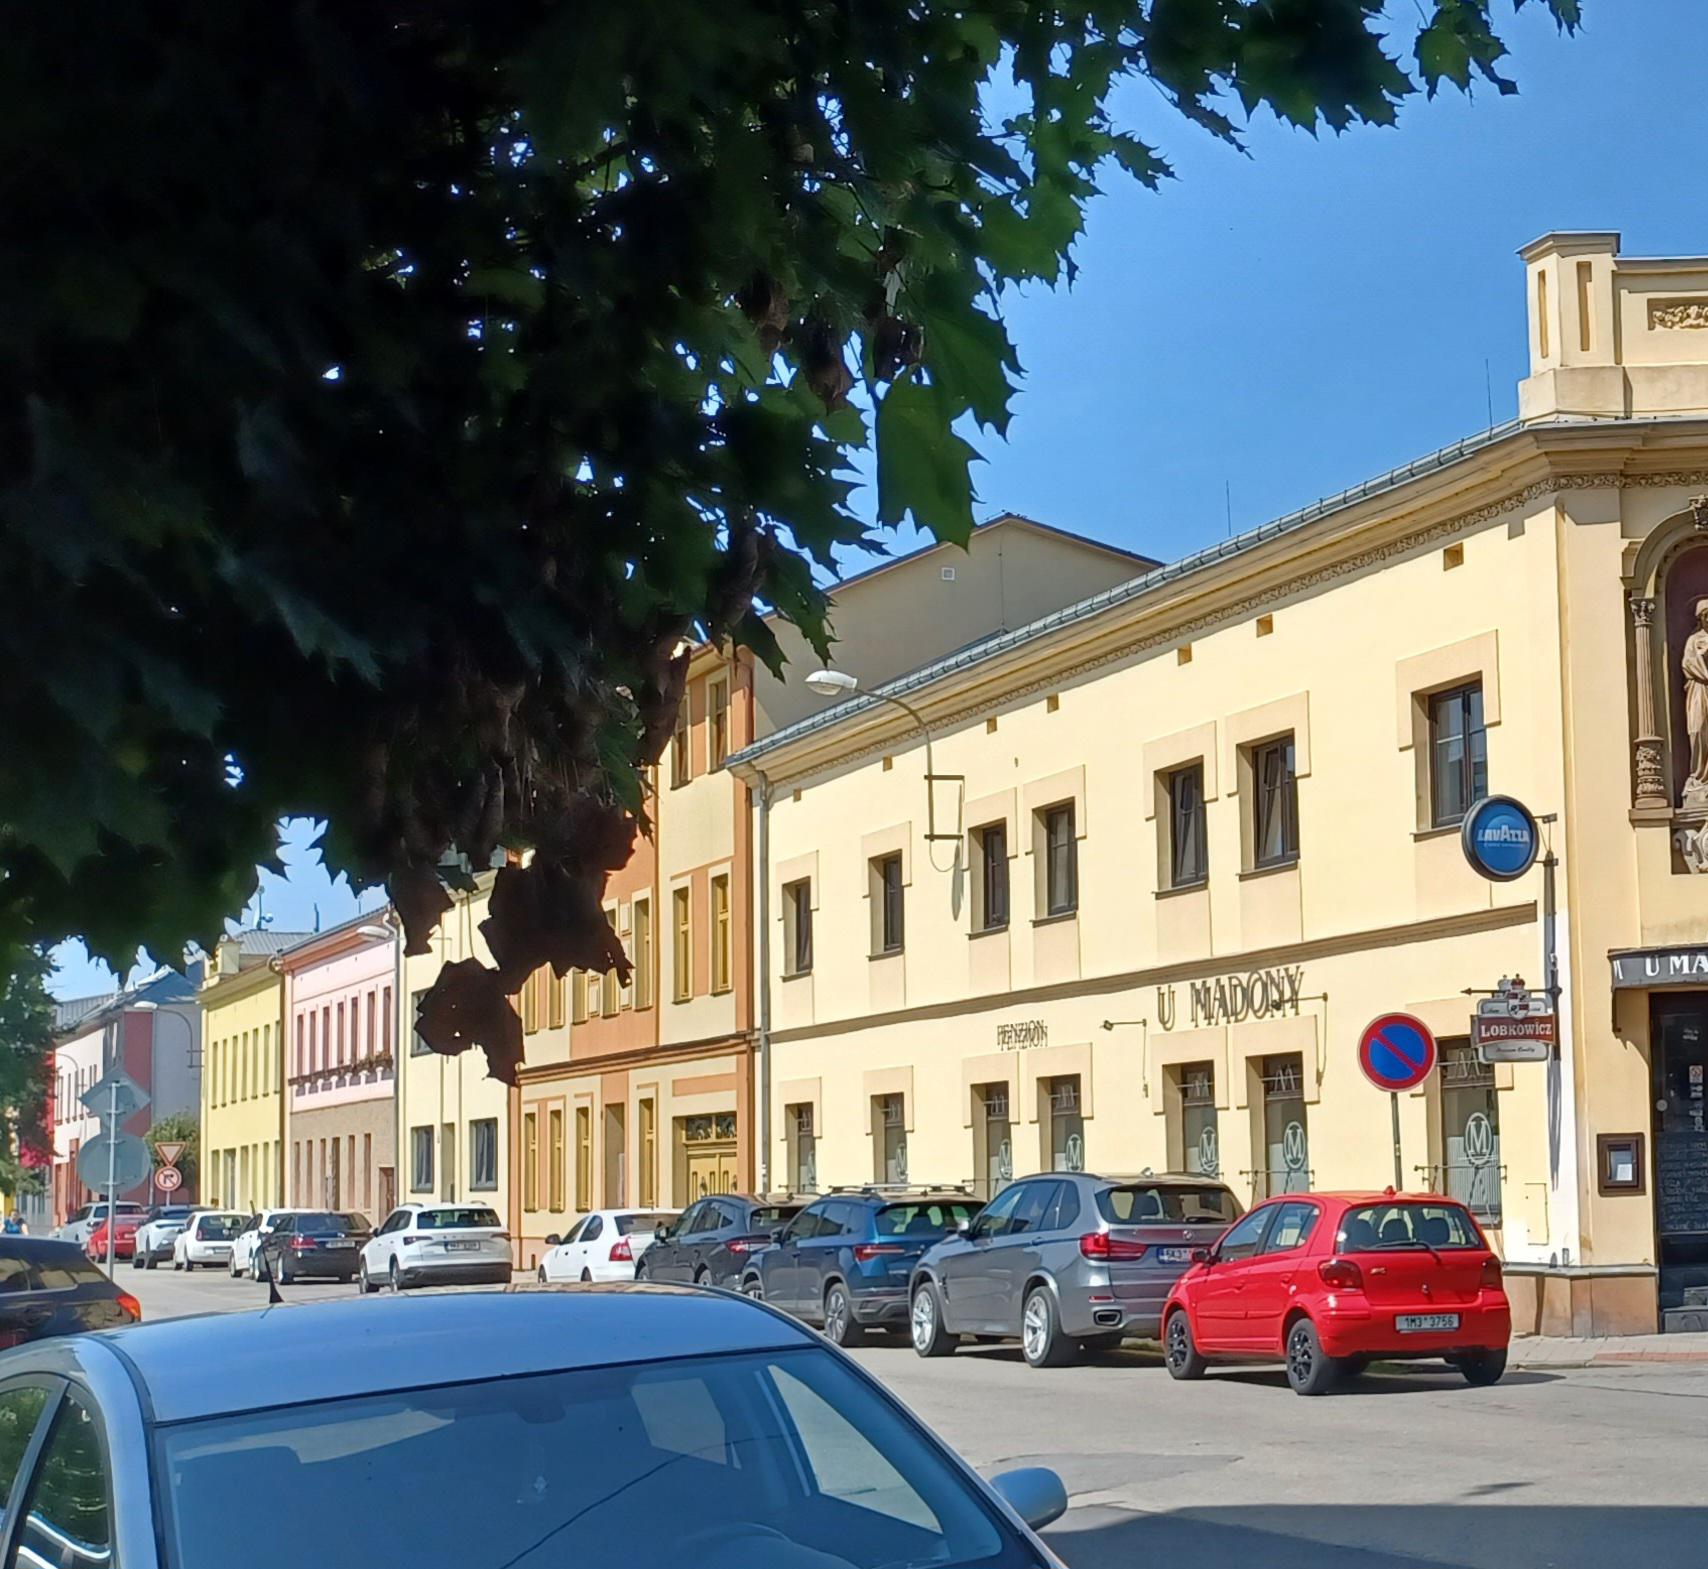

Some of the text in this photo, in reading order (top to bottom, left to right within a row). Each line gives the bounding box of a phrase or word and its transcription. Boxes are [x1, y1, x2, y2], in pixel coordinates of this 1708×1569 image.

[1645, 955, 1660, 977] U
[1157, 965, 1304, 1031] U MADONY
[997, 1019, 1048, 1051] PENZION
[1480, 1021, 1552, 1038] LOBKOWICZ
